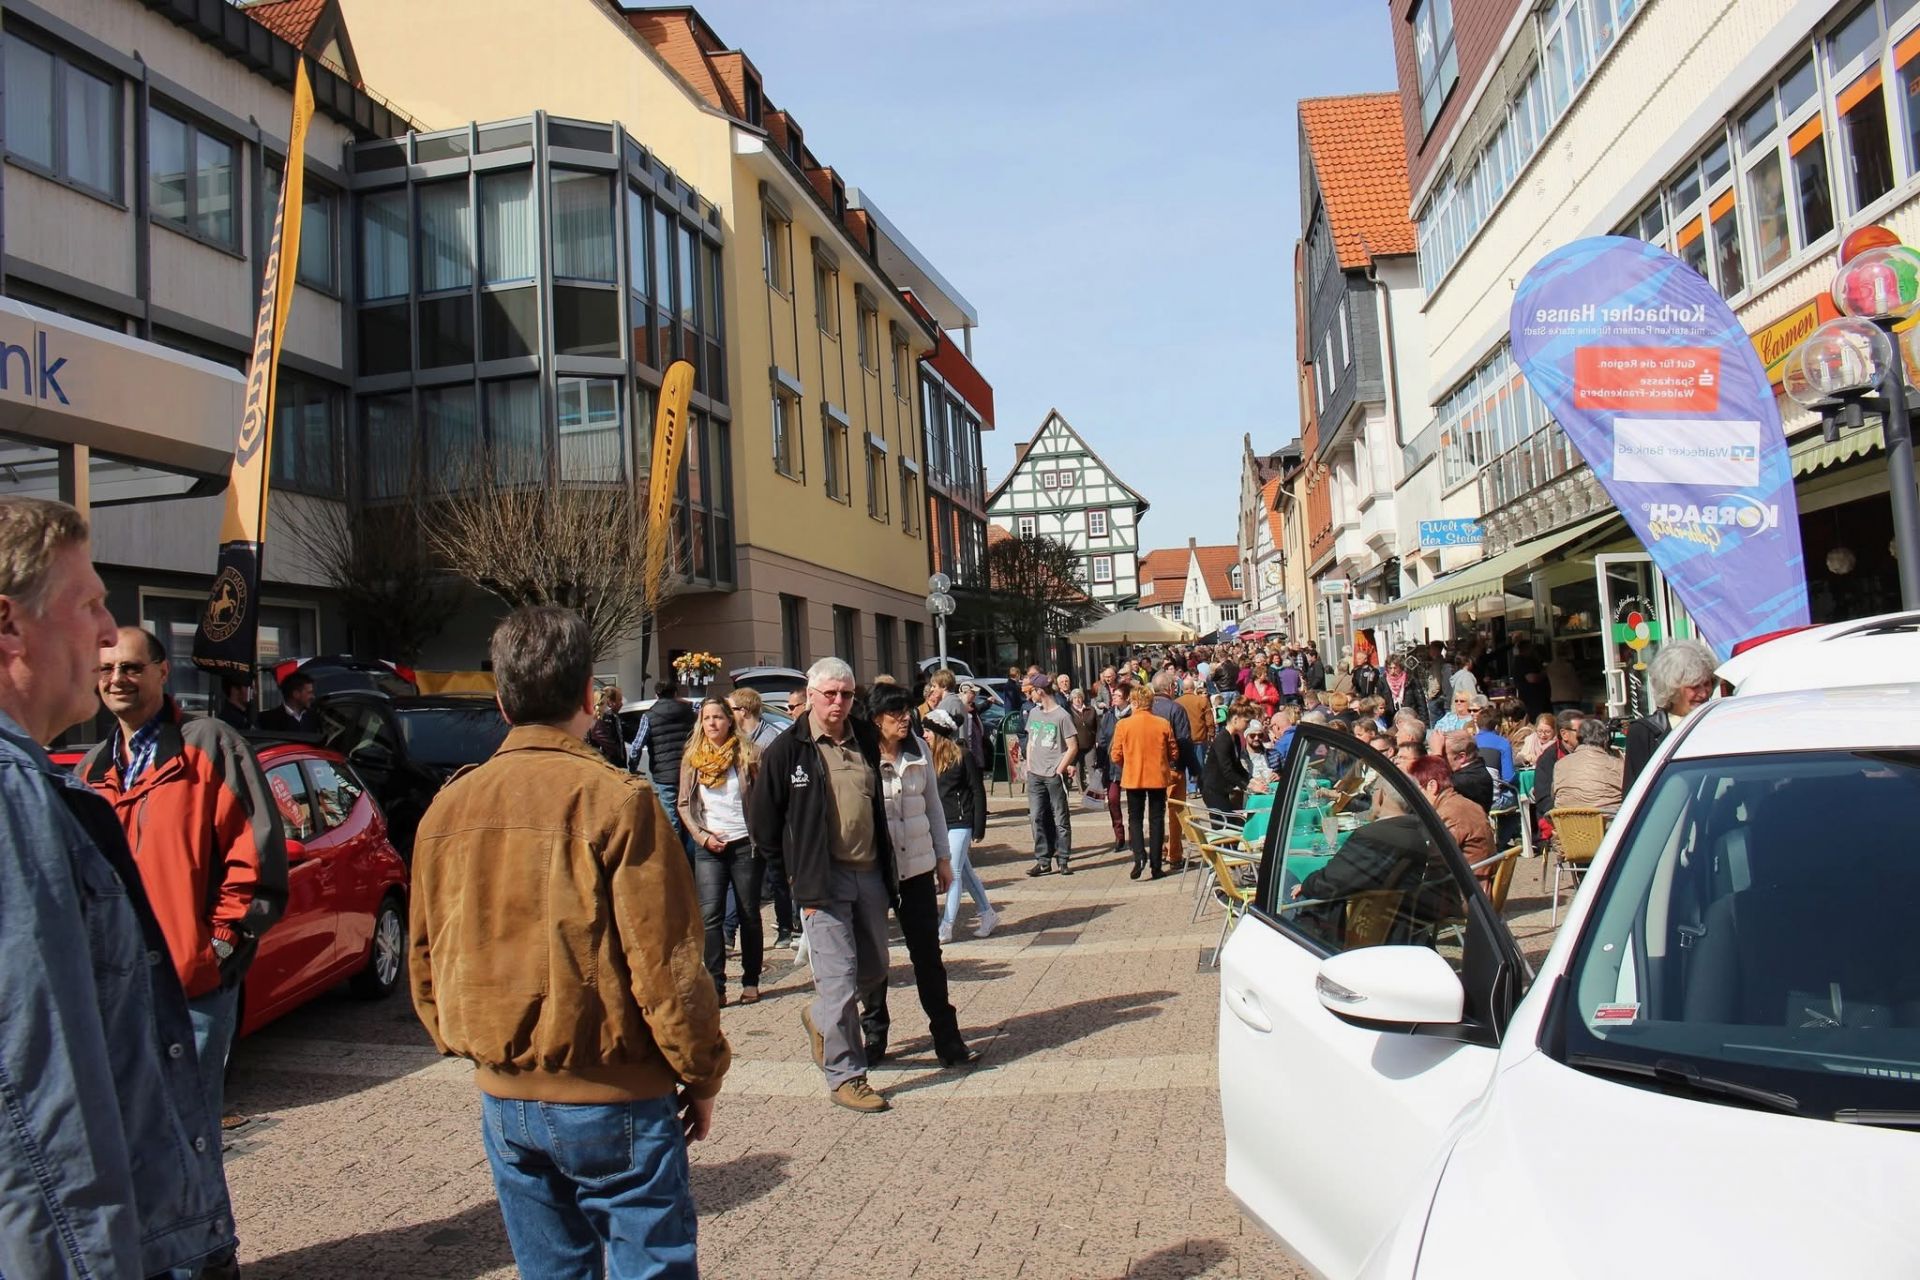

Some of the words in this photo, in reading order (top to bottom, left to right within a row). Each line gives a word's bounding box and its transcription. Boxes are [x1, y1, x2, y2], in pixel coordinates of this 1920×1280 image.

[1760, 311, 1814, 365] Carmen
[1421, 520, 1458, 534] Welt
[1422, 534, 1441, 546] der
